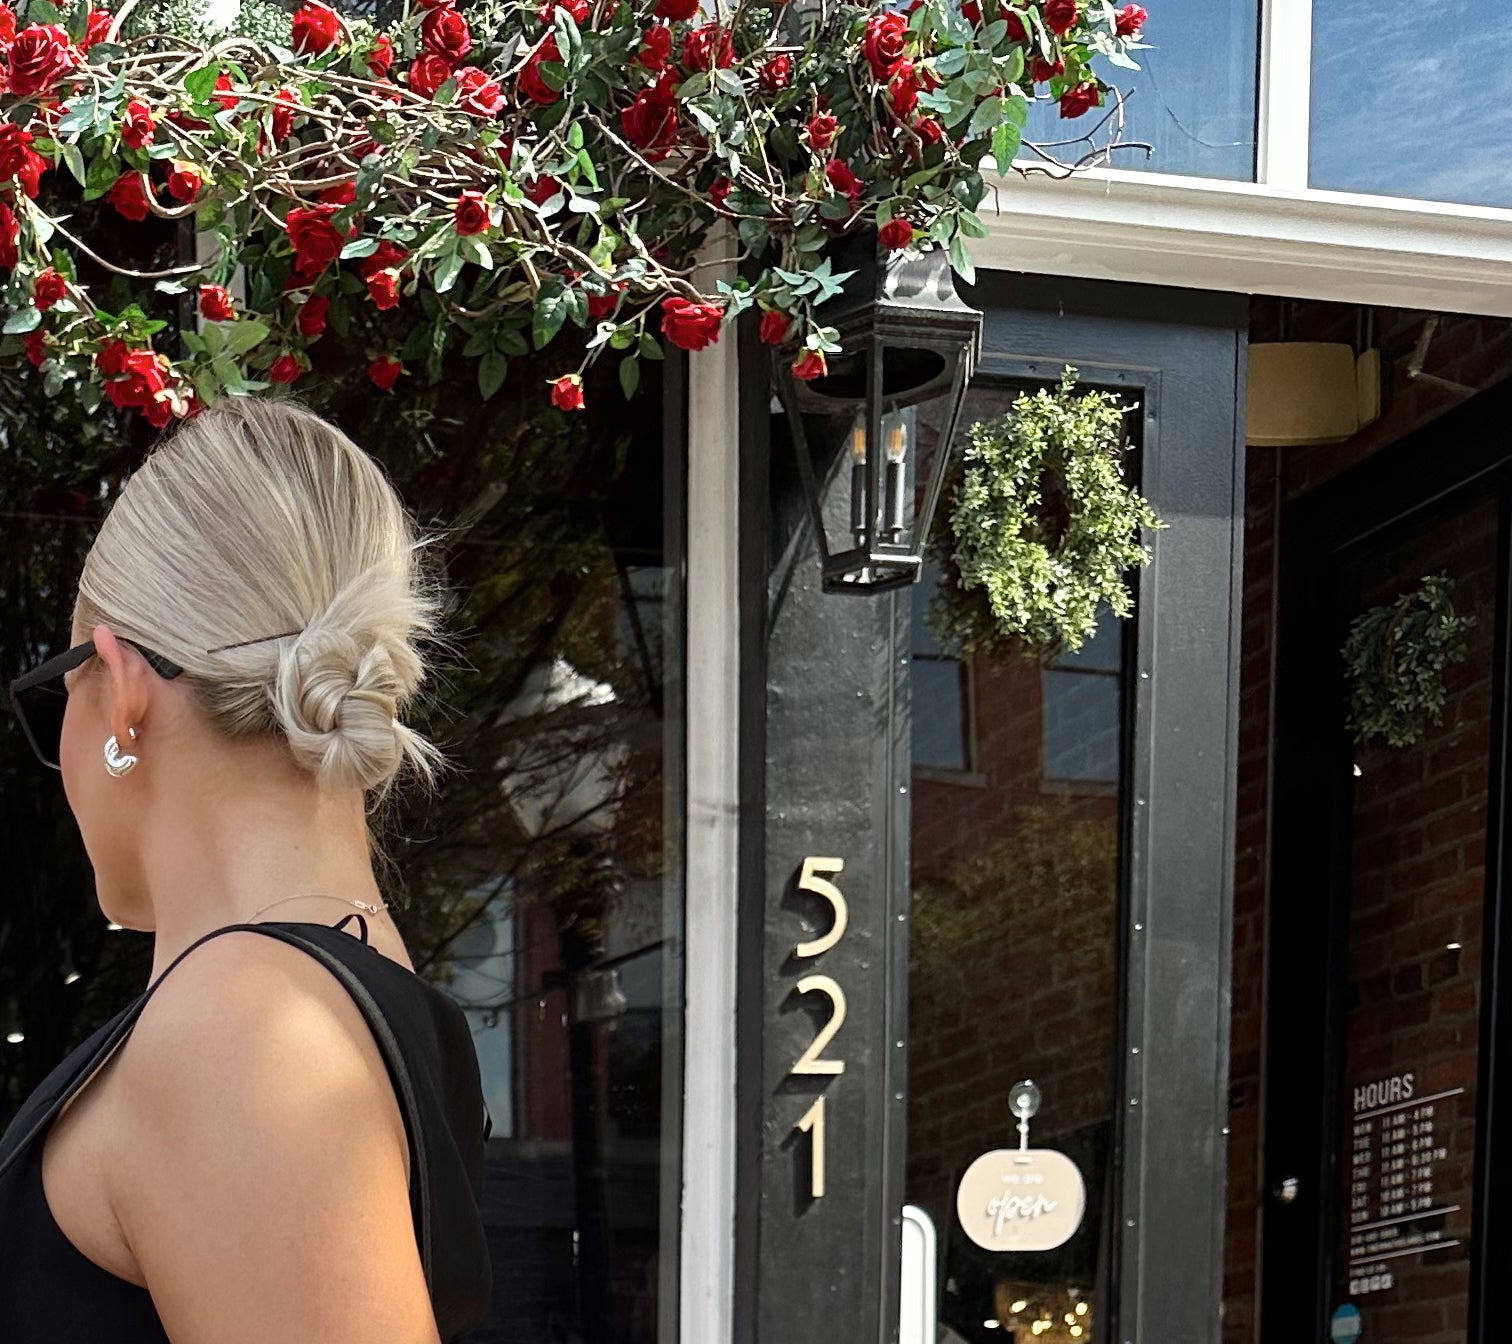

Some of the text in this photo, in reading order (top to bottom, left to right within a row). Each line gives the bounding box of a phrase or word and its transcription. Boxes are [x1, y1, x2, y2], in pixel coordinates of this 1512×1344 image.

[791, 856, 848, 1198] 521
[1354, 1073, 1415, 1112] HOURS
[987, 1190, 1058, 1236] open
